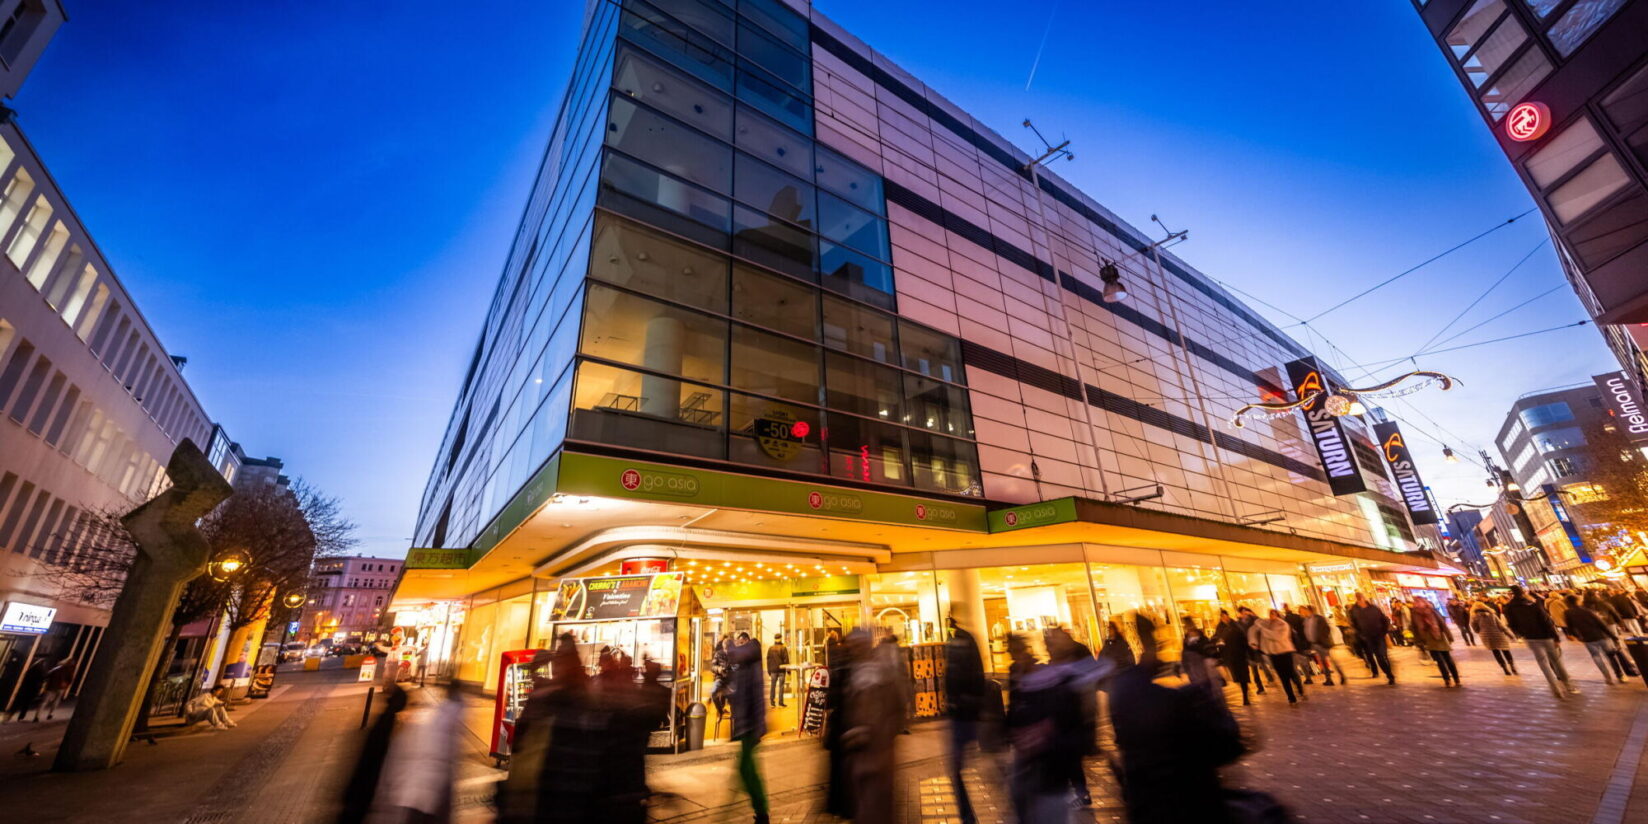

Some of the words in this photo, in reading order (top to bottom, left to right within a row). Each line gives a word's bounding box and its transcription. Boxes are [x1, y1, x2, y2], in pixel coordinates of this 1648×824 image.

[1308, 408, 1354, 478] SATURN
[643, 475, 664, 491] go
[668, 478, 696, 491] asia
[1393, 461, 1430, 512] SATURN
[824, 496, 838, 509] go
[840, 498, 861, 509] asia
[927, 508, 938, 520] go
[939, 510, 956, 520] asia
[1019, 511, 1032, 525] go
[1033, 506, 1056, 518] asia
